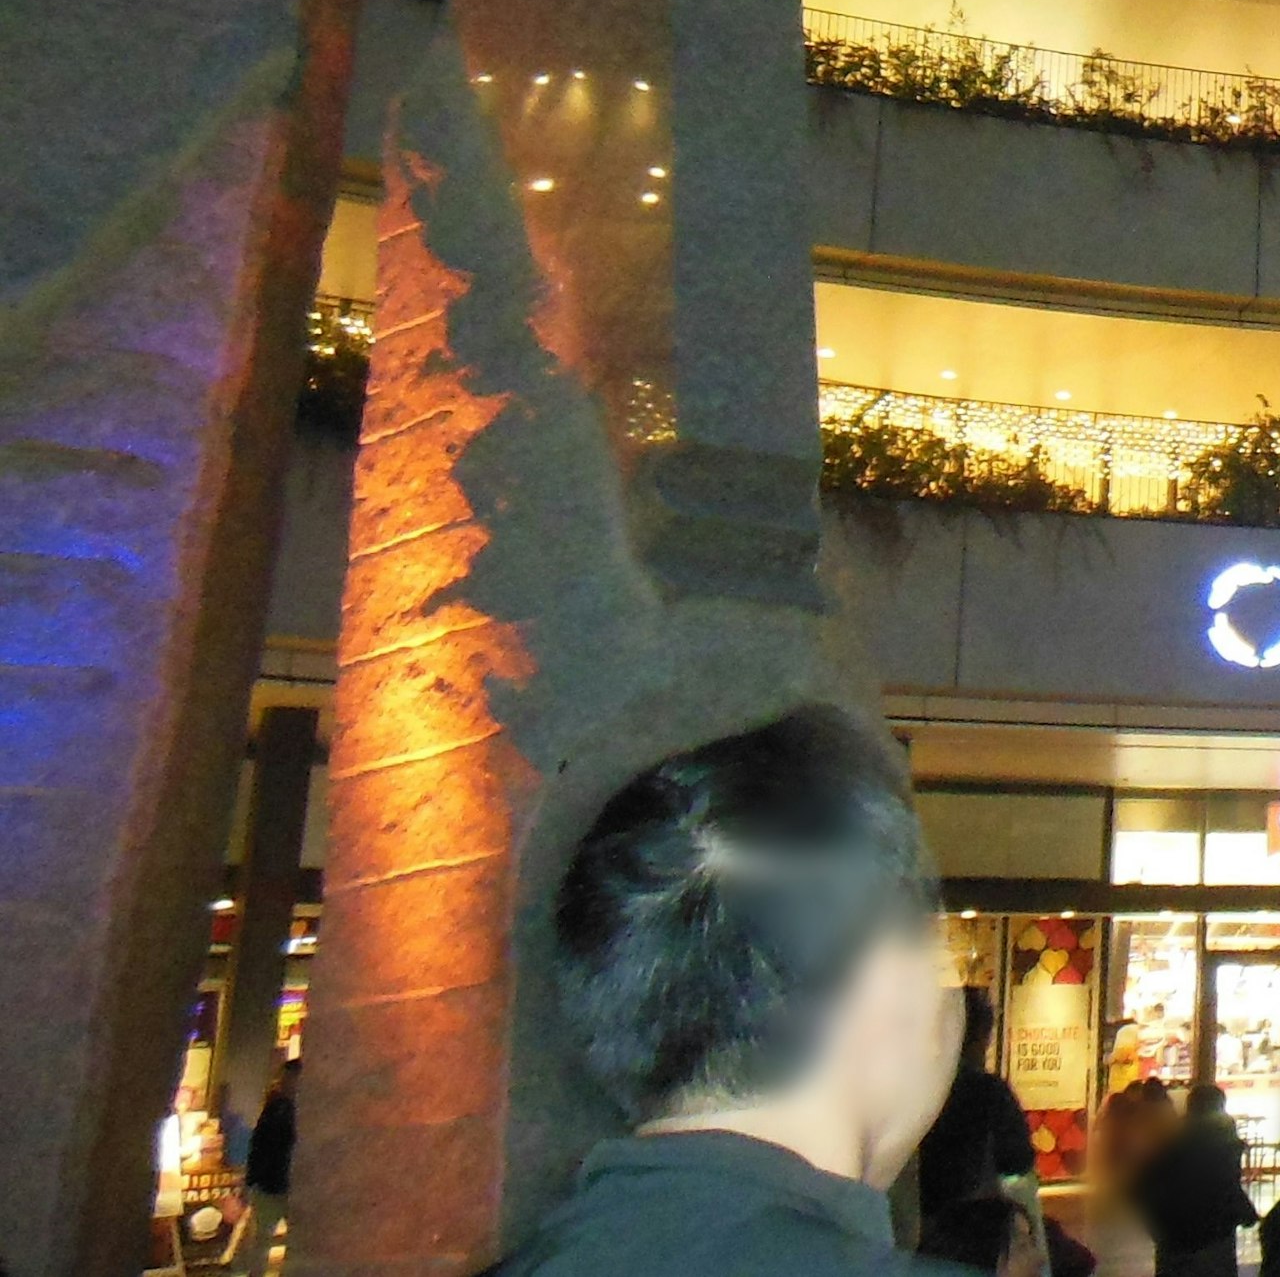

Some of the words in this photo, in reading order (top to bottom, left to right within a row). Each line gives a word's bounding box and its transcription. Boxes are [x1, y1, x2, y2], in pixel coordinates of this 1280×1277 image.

[1017, 1042, 1028, 1057] IS
[1031, 1042, 1060, 1056] GOOD
[1017, 1057, 1038, 1071] FOR
[1042, 1057, 1062, 1071] YOU
